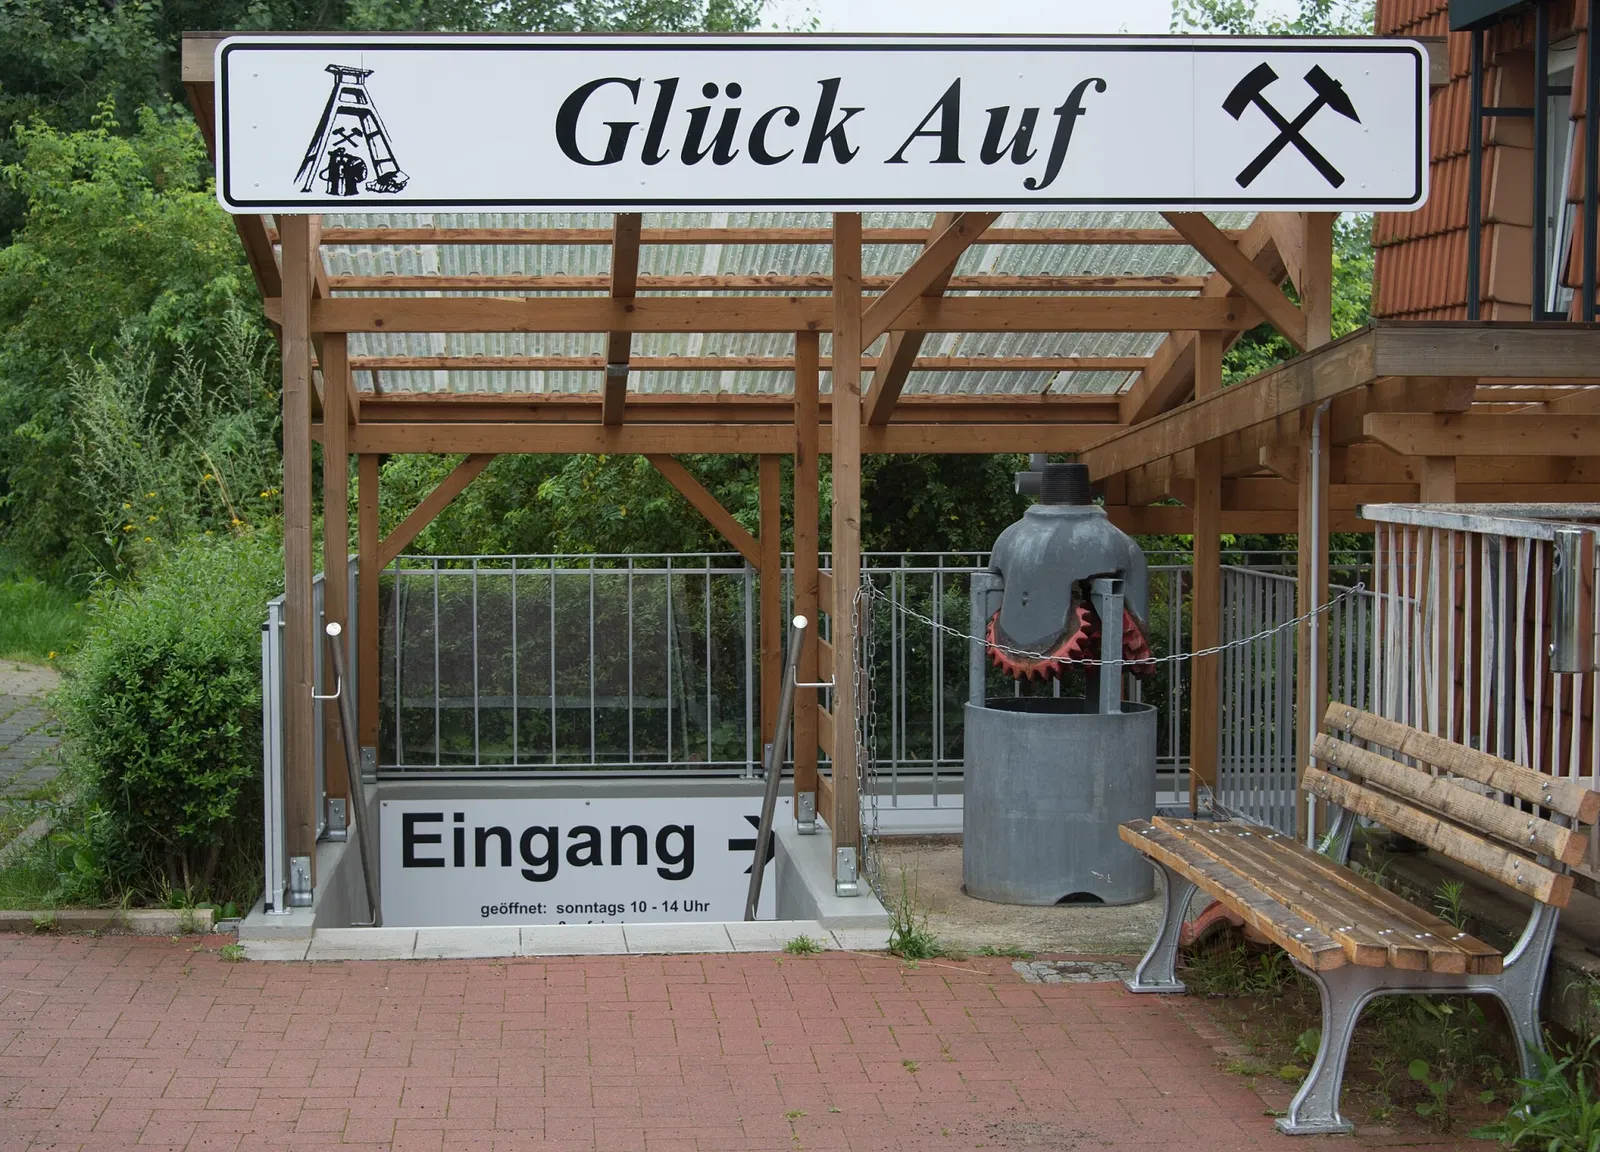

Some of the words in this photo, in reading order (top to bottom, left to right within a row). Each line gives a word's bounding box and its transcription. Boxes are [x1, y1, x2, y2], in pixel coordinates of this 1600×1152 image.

[555, 77, 866, 167] Glück
[883, 76, 1107, 191] Auf
[401, 811, 695, 883] Eingang
[480, 901, 547, 917] geöffnet:
[556, 901, 626, 917] sonntags
[630, 900, 648, 915] 10
[661, 899, 679, 914] 14
[683, 899, 711, 914] Uhr
